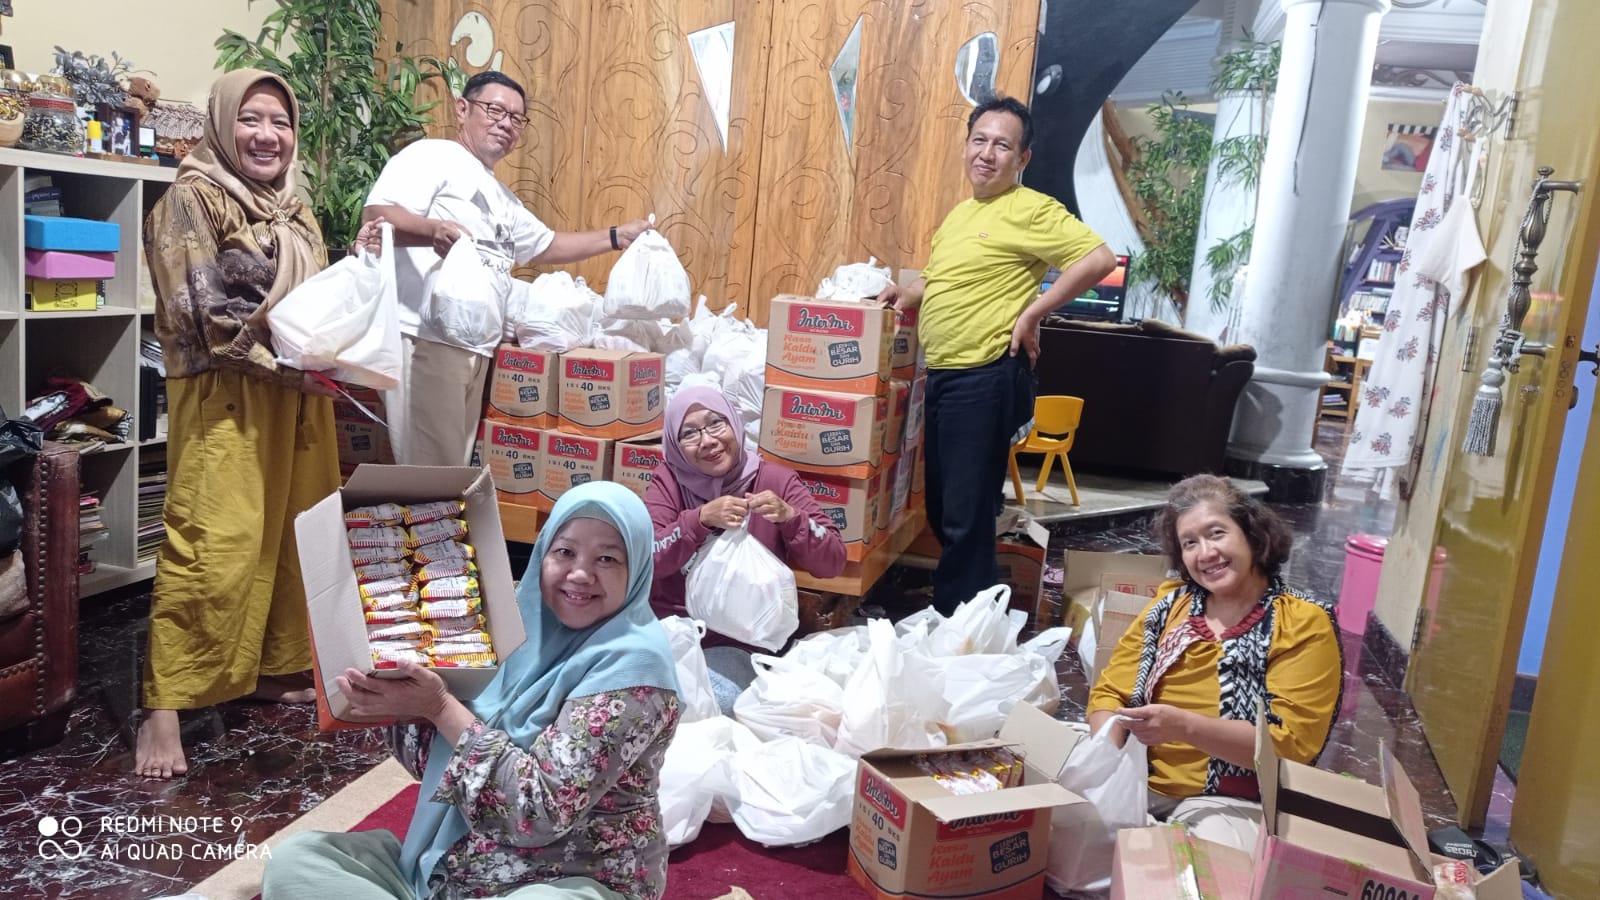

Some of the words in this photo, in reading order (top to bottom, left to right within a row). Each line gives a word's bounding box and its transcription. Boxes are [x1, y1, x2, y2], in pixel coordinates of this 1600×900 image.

[797, 308, 854, 330] InterMi
[783, 342, 816, 354] Kaldu
[830, 345, 858, 356] BESAR
[783, 352, 816, 364] Ayam
[832, 357, 859, 366] GURIH
[511, 373, 524, 383] 40
[580, 382, 594, 391] 40
[790, 395, 845, 420] InterMi
[821, 434, 850, 444] BESAR
[505, 450, 519, 460] 40
[823, 445, 851, 454] GURIH
[629, 451, 660, 466] InterM
[562, 460, 576, 470] 40
[638, 472, 652, 481] 40
[871, 812, 884, 830] 40
[992, 839, 1027, 858] BESAR
[929, 854, 977, 869] Kaldu
[993, 852, 1028, 872] GURIH
[927, 868, 974, 884] Ayam
